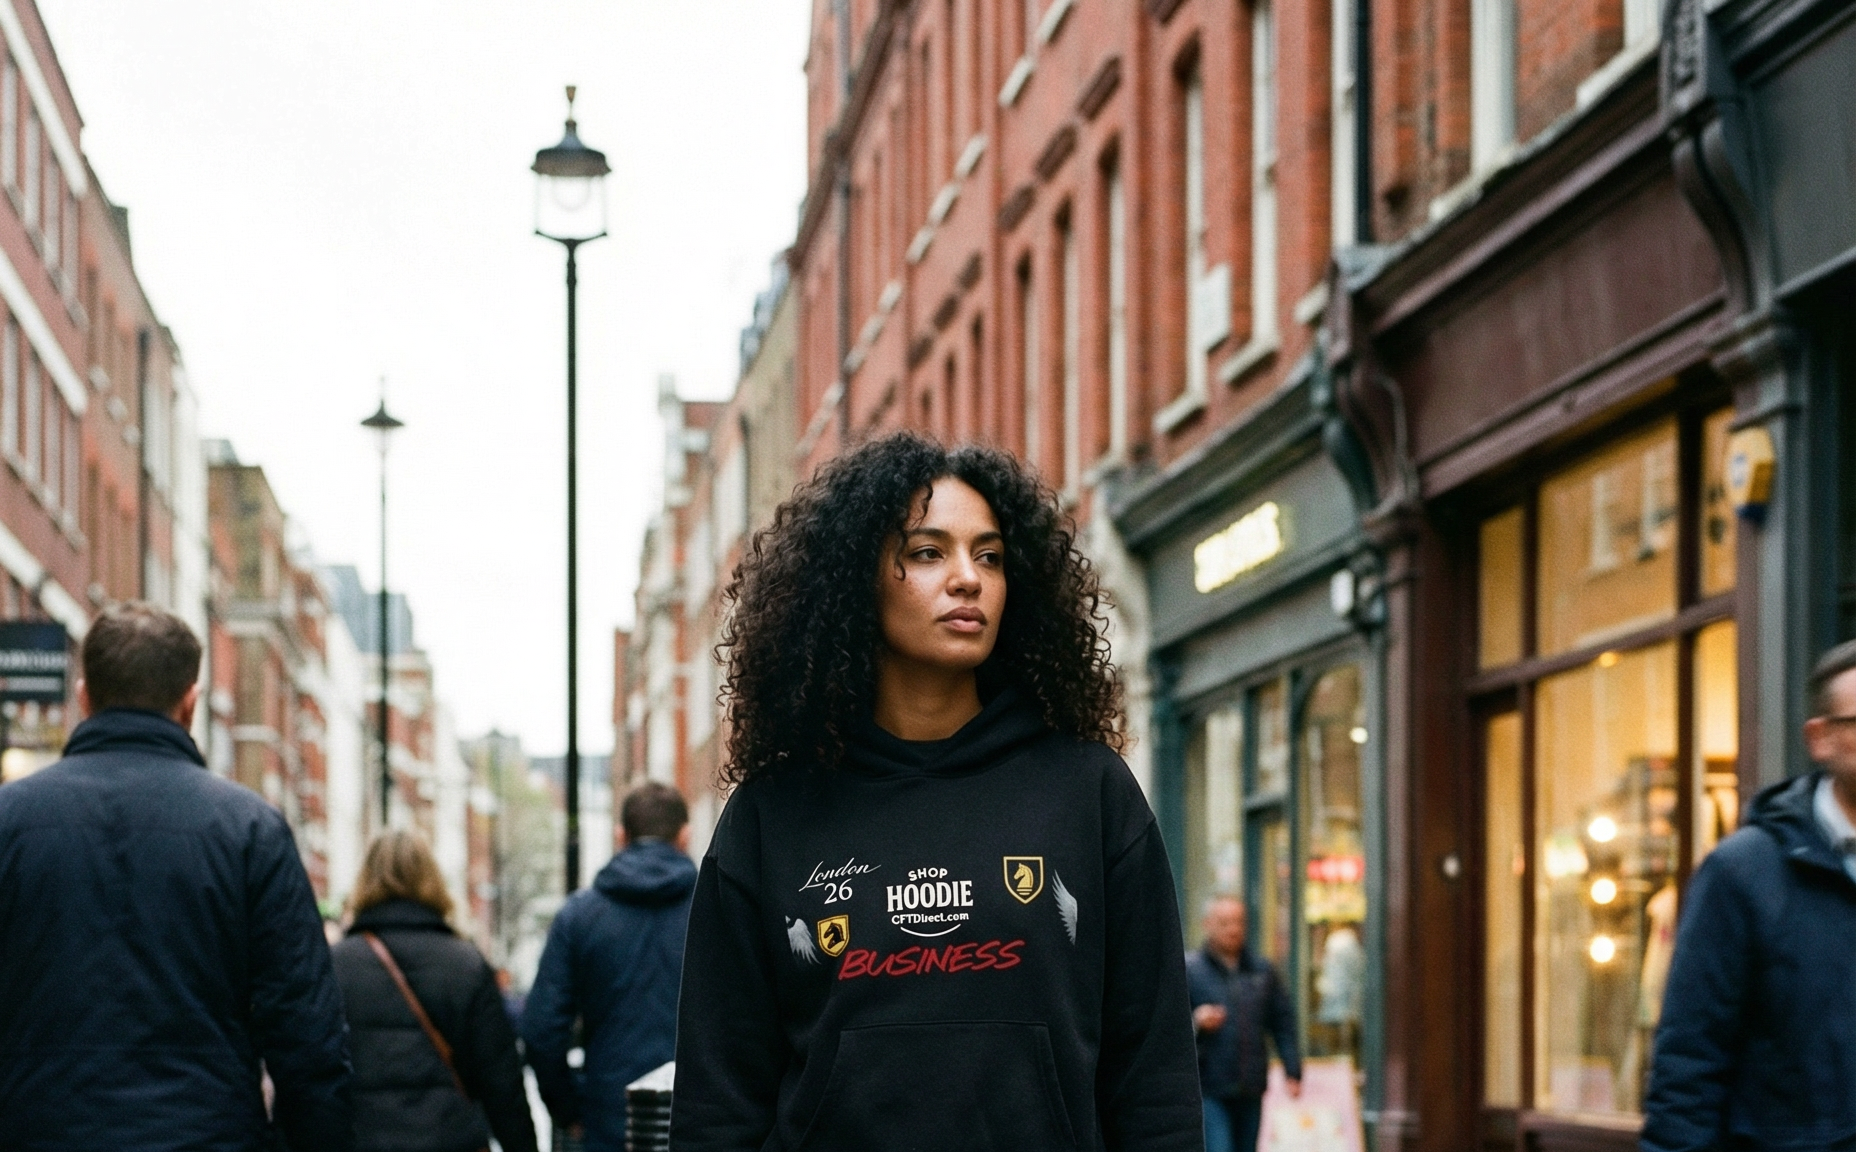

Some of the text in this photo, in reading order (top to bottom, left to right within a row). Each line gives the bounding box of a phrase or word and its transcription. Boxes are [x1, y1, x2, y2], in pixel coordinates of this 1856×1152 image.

[798, 857, 882, 892] London
[824, 877, 853, 905] 26
[908, 867, 948, 882] SHOP
[886, 880, 974, 913] HOODIE
[838, 940, 1025, 980] BUSINESS
